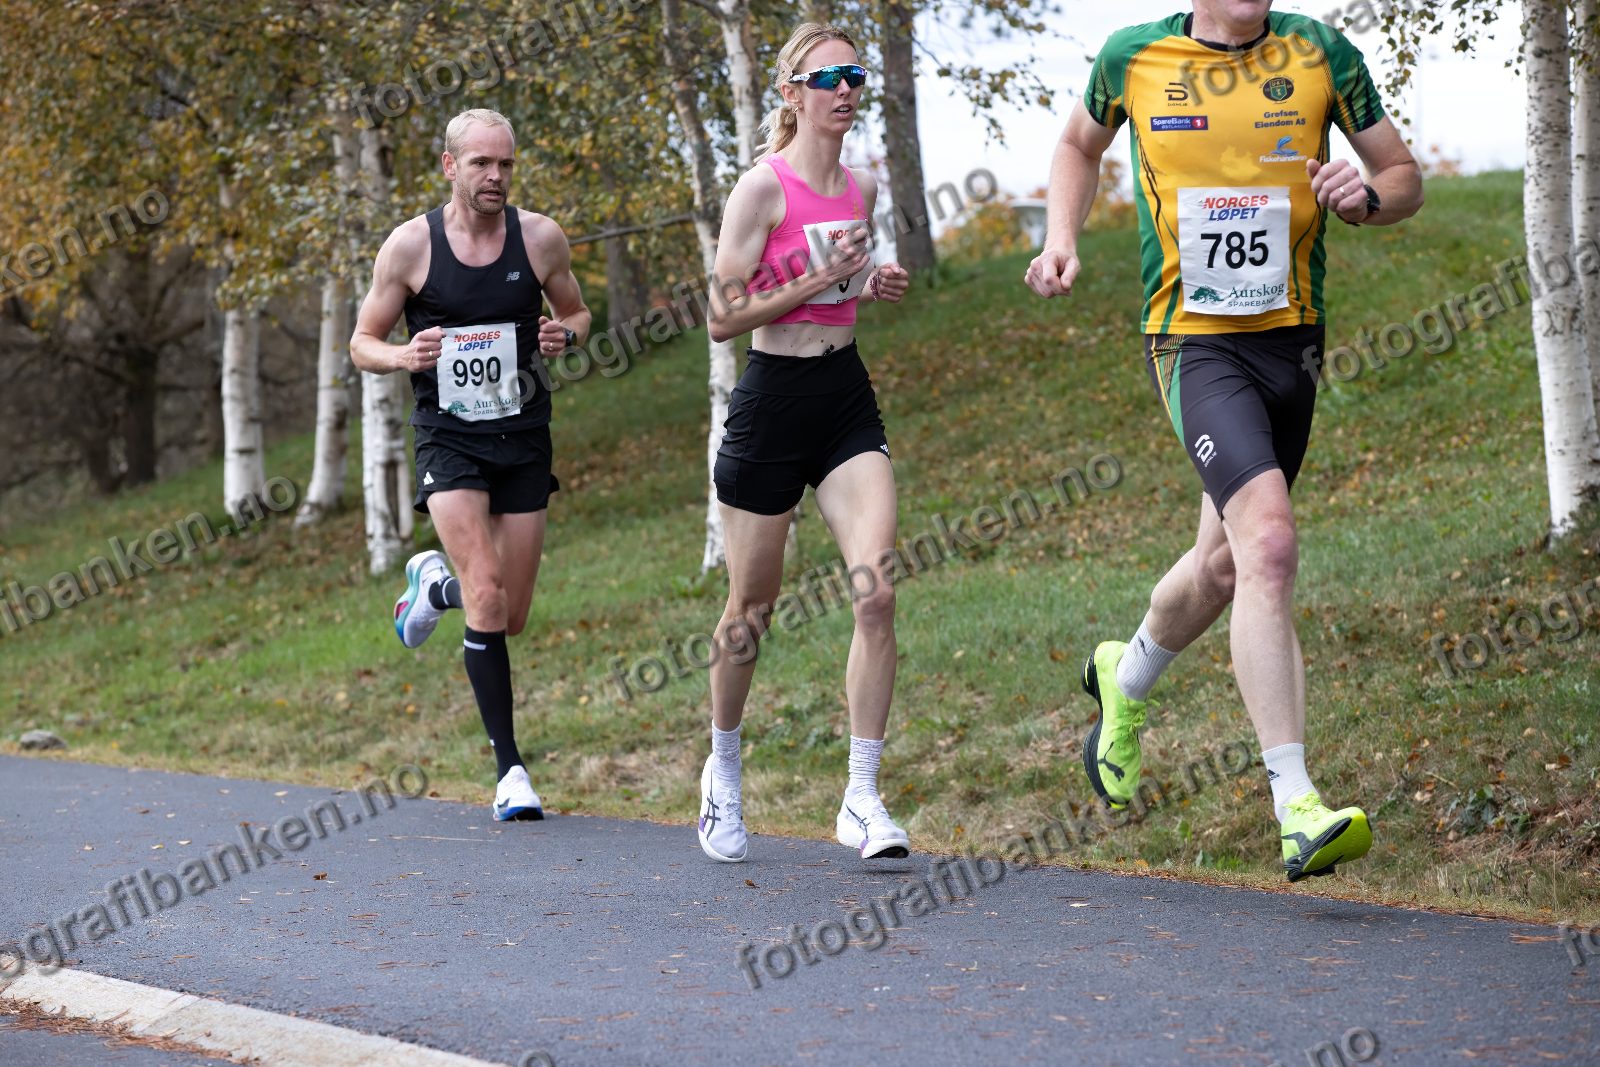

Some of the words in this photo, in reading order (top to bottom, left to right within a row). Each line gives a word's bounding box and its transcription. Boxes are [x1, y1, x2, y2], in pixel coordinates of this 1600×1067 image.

[1263, 109, 1299, 119] Grefsen
[1152, 117, 1191, 126] SpareBank
[1295, 117, 1306, 125] AS
[1202, 194, 1269, 210] NORGES
[1208, 207, 1260, 222] LØPET
[1200, 229, 1269, 270] 785
[1228, 283, 1285, 298] Aurskog
[1227, 296, 1276, 308] SPAREBANK
[454, 330, 501, 343] NORGES
[457, 340, 494, 352] LØPET
[452, 356, 502, 388] 990
[473, 395, 517, 409] Aurskog
